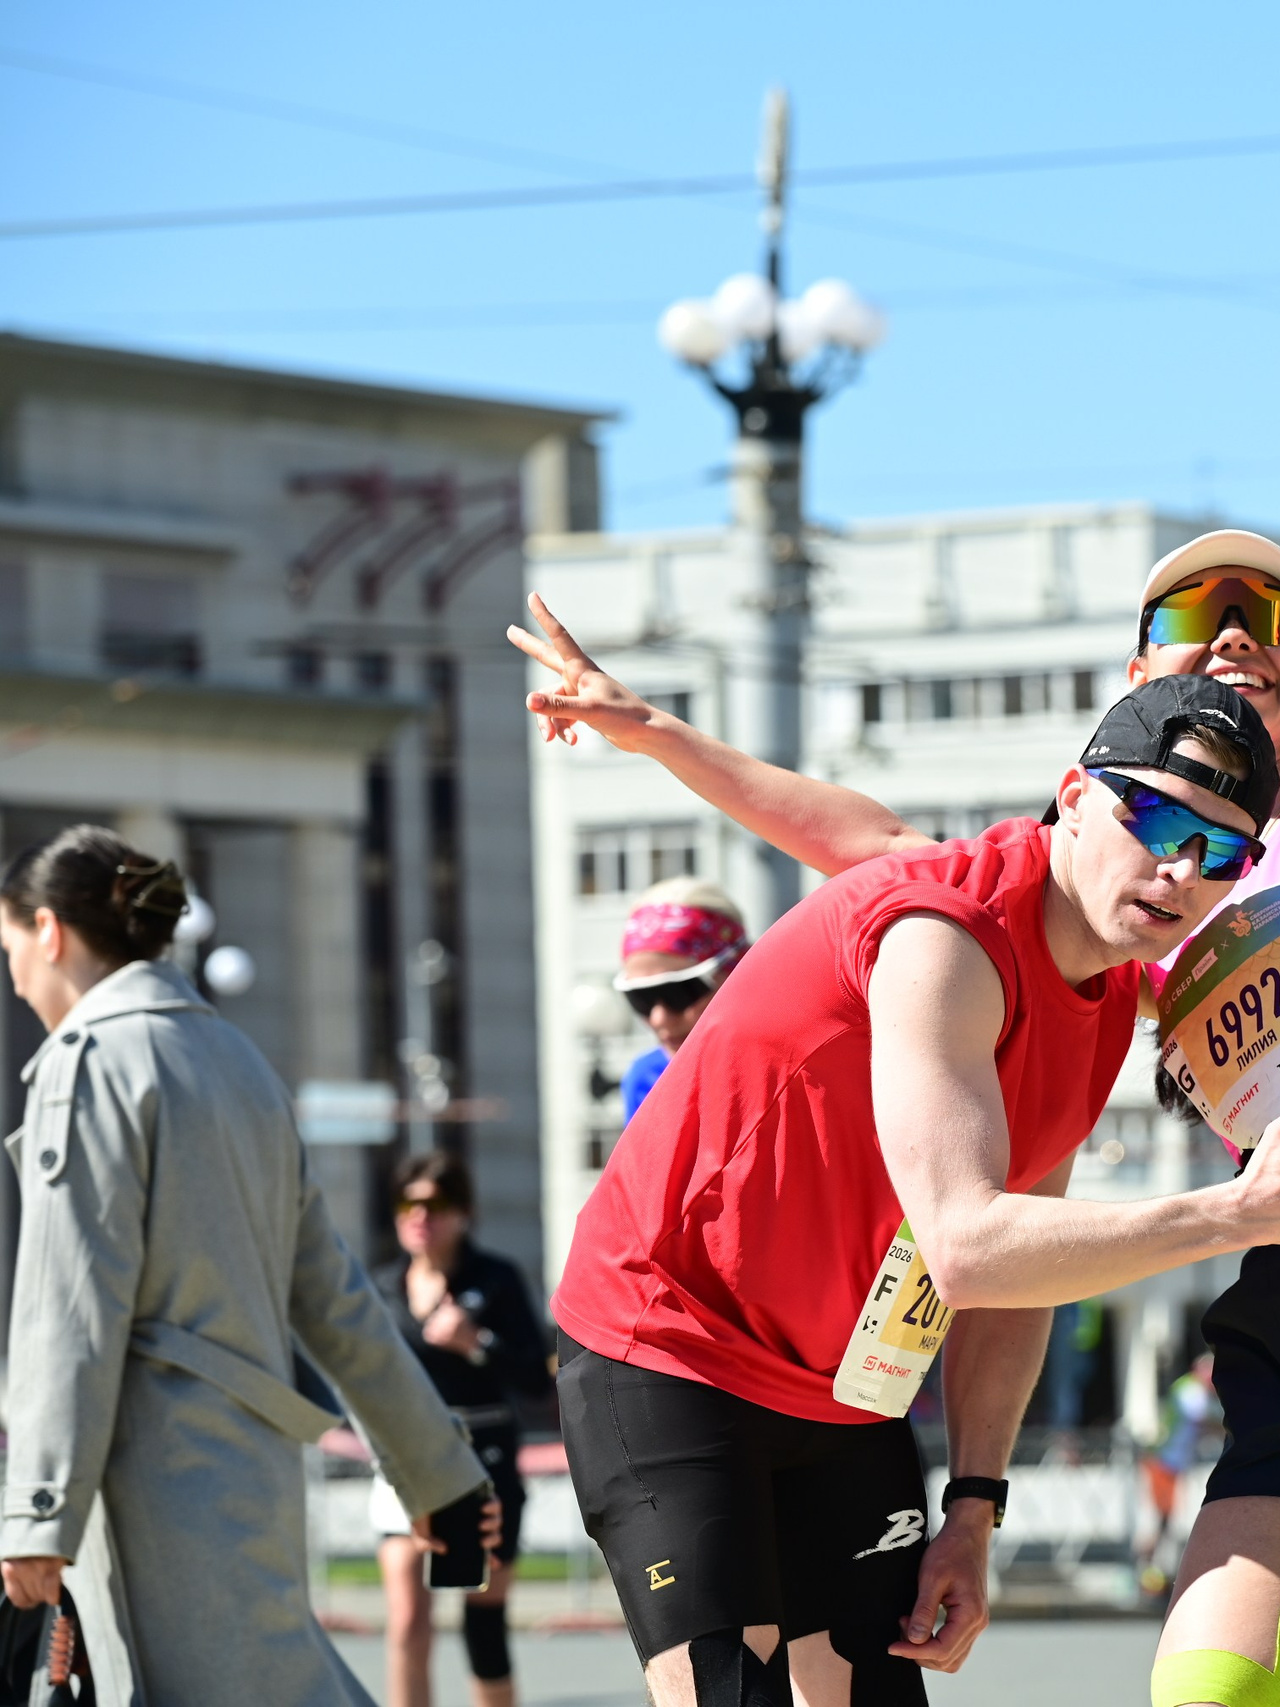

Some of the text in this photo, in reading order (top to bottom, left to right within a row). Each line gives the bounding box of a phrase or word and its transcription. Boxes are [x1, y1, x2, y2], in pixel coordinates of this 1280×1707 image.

[1171, 975, 1192, 1002] СБЕР
[1236, 1028, 1278, 1072] ЛИЛИЯ
[1178, 1063, 1196, 1094] G
[1227, 1082, 1260, 1123] МАГНИТ
[888, 1245, 912, 1263] 2026
[873, 1273, 898, 1302] F
[876, 1360, 912, 1379] МАГНИТ
